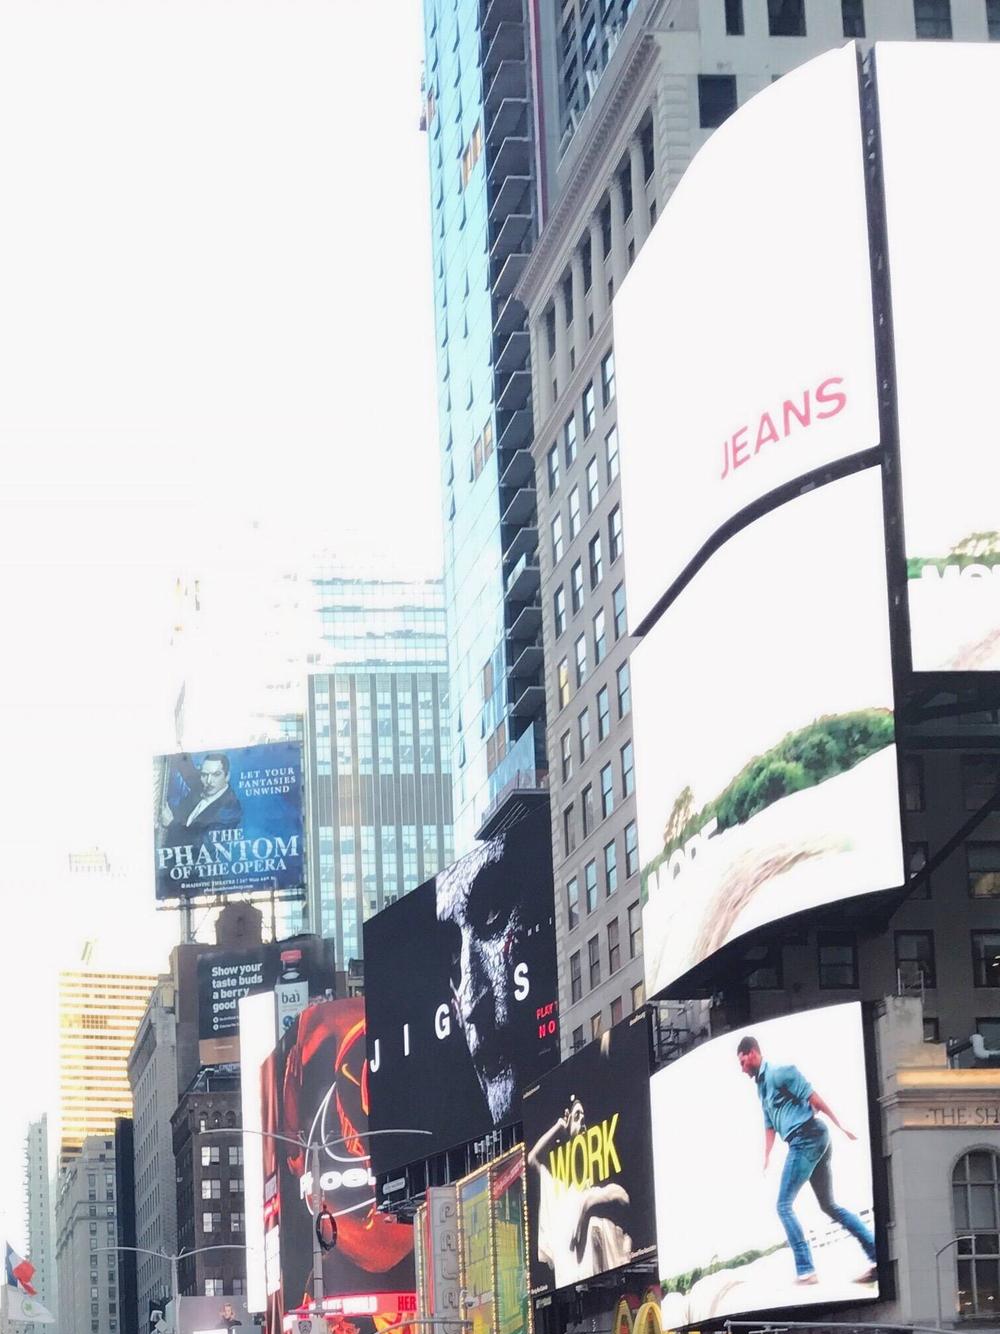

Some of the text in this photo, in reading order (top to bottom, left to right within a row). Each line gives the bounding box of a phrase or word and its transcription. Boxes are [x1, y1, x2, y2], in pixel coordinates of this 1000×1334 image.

[721, 377, 847, 480] JEANS
[240, 767, 294, 779] LET YOUR
[240, 776, 296, 788] FANTASIES
[245, 785, 290, 796] UNWIND
[209, 828, 243, 842] THE
[157, 835, 299, 869] PHANTOM
[170, 858, 287, 880] OF THE OPERA
[212, 963, 263, 977] Show your
[212, 974, 263, 989] taste buds
[213, 987, 249, 999] a berry
[281, 992, 300, 1004] bai
[213, 999, 236, 1013] good
[929, 1107, 967, 1124] THE
[550, 1112, 622, 1192] WORK
